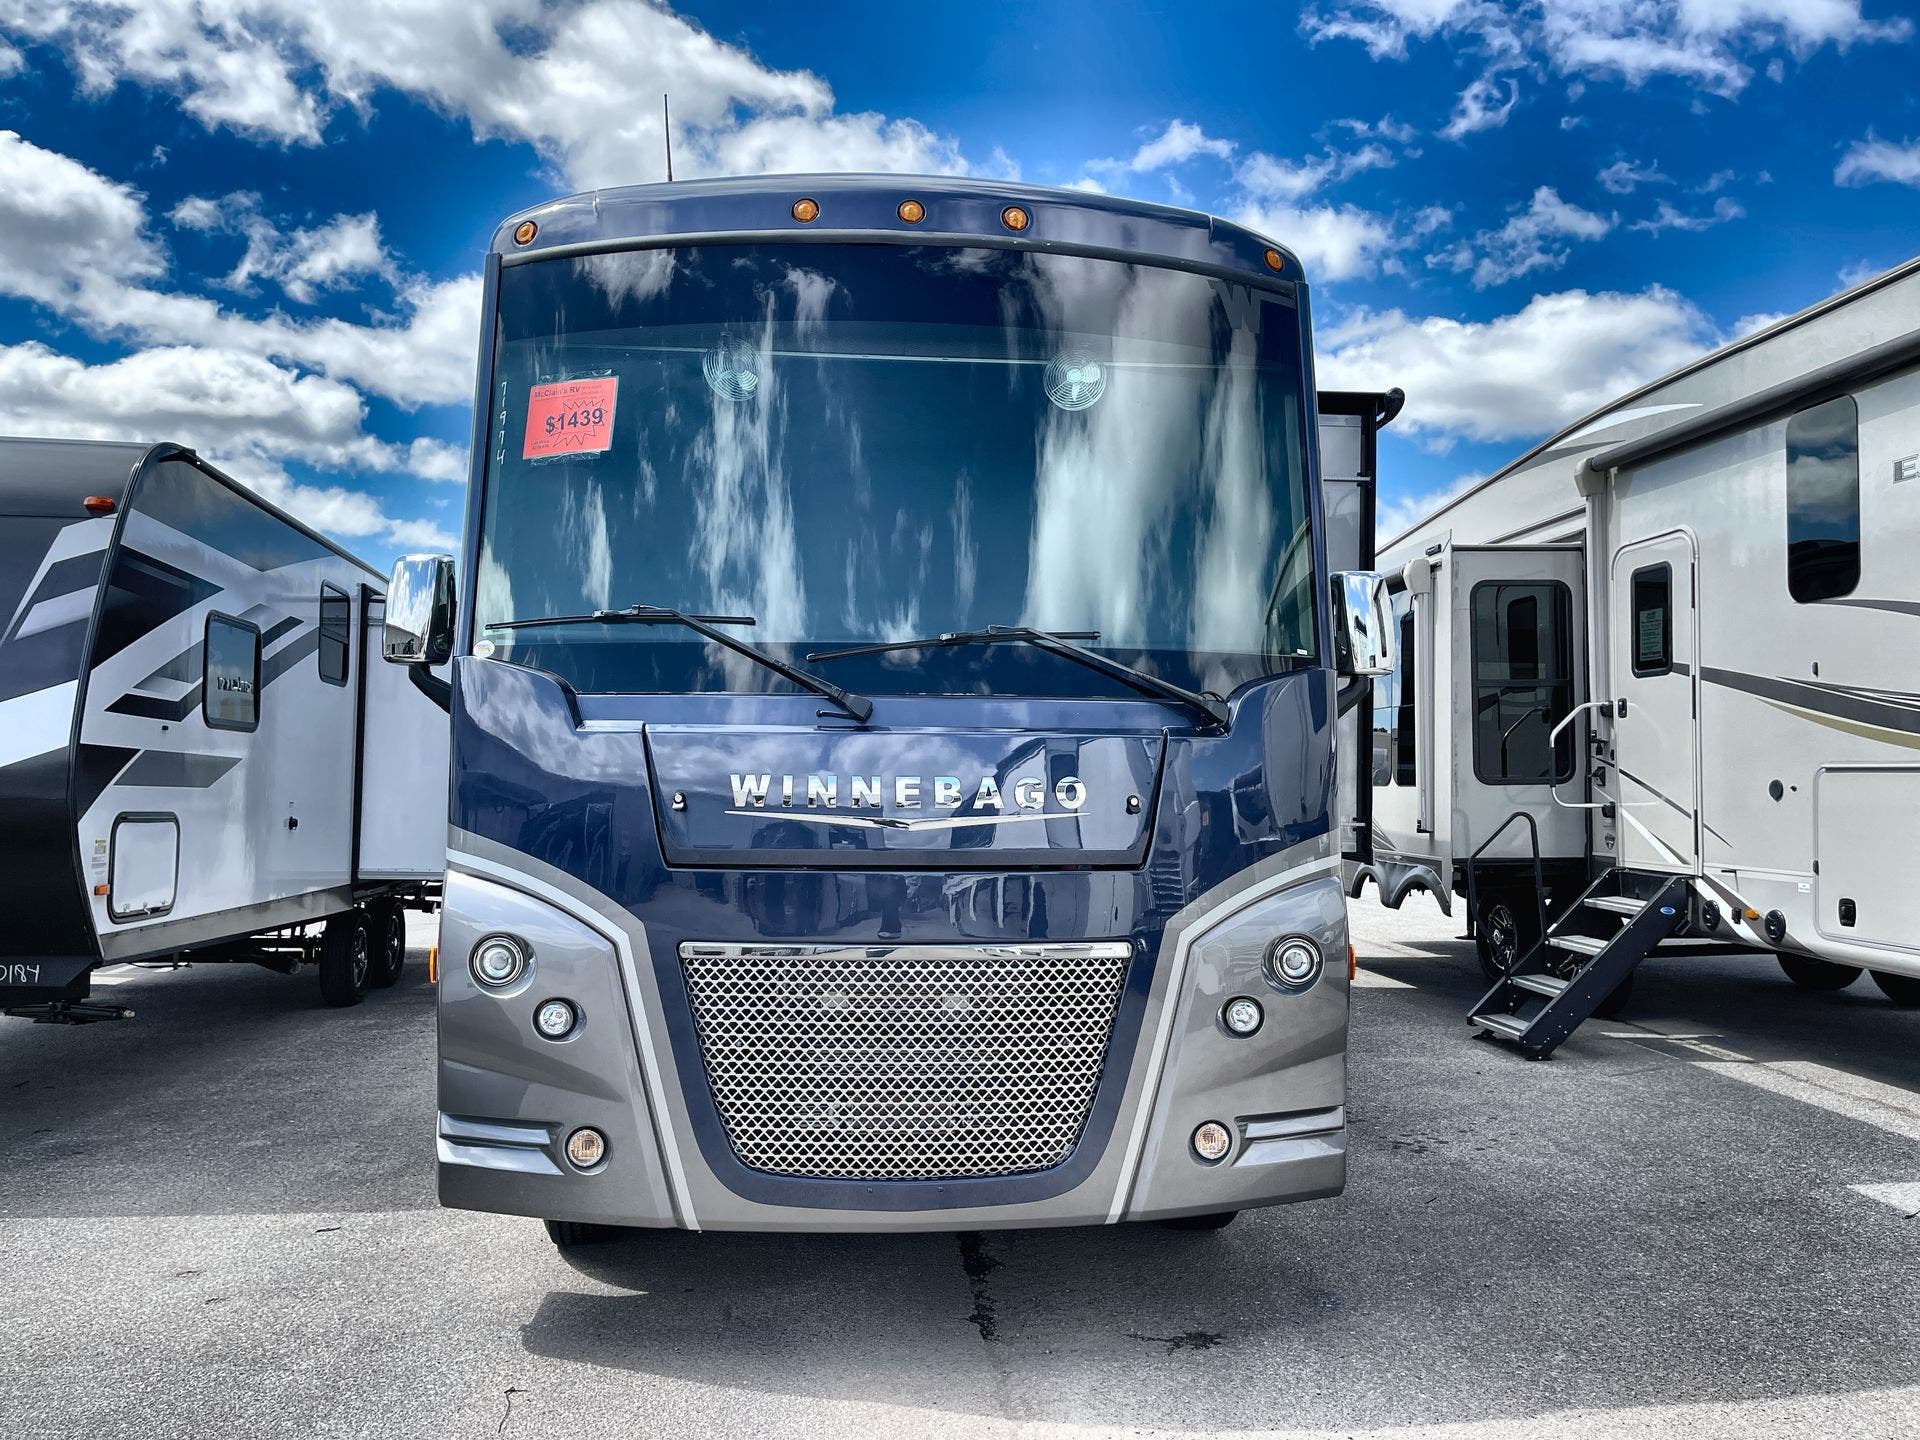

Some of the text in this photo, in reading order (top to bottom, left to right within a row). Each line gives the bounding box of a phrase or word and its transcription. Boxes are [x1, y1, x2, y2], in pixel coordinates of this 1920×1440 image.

[534, 387, 568, 399] McClain's
[569, 385, 581, 394] RV
[545, 408, 604, 434] $1439
[729, 774, 1087, 810] WINNEBAGO
